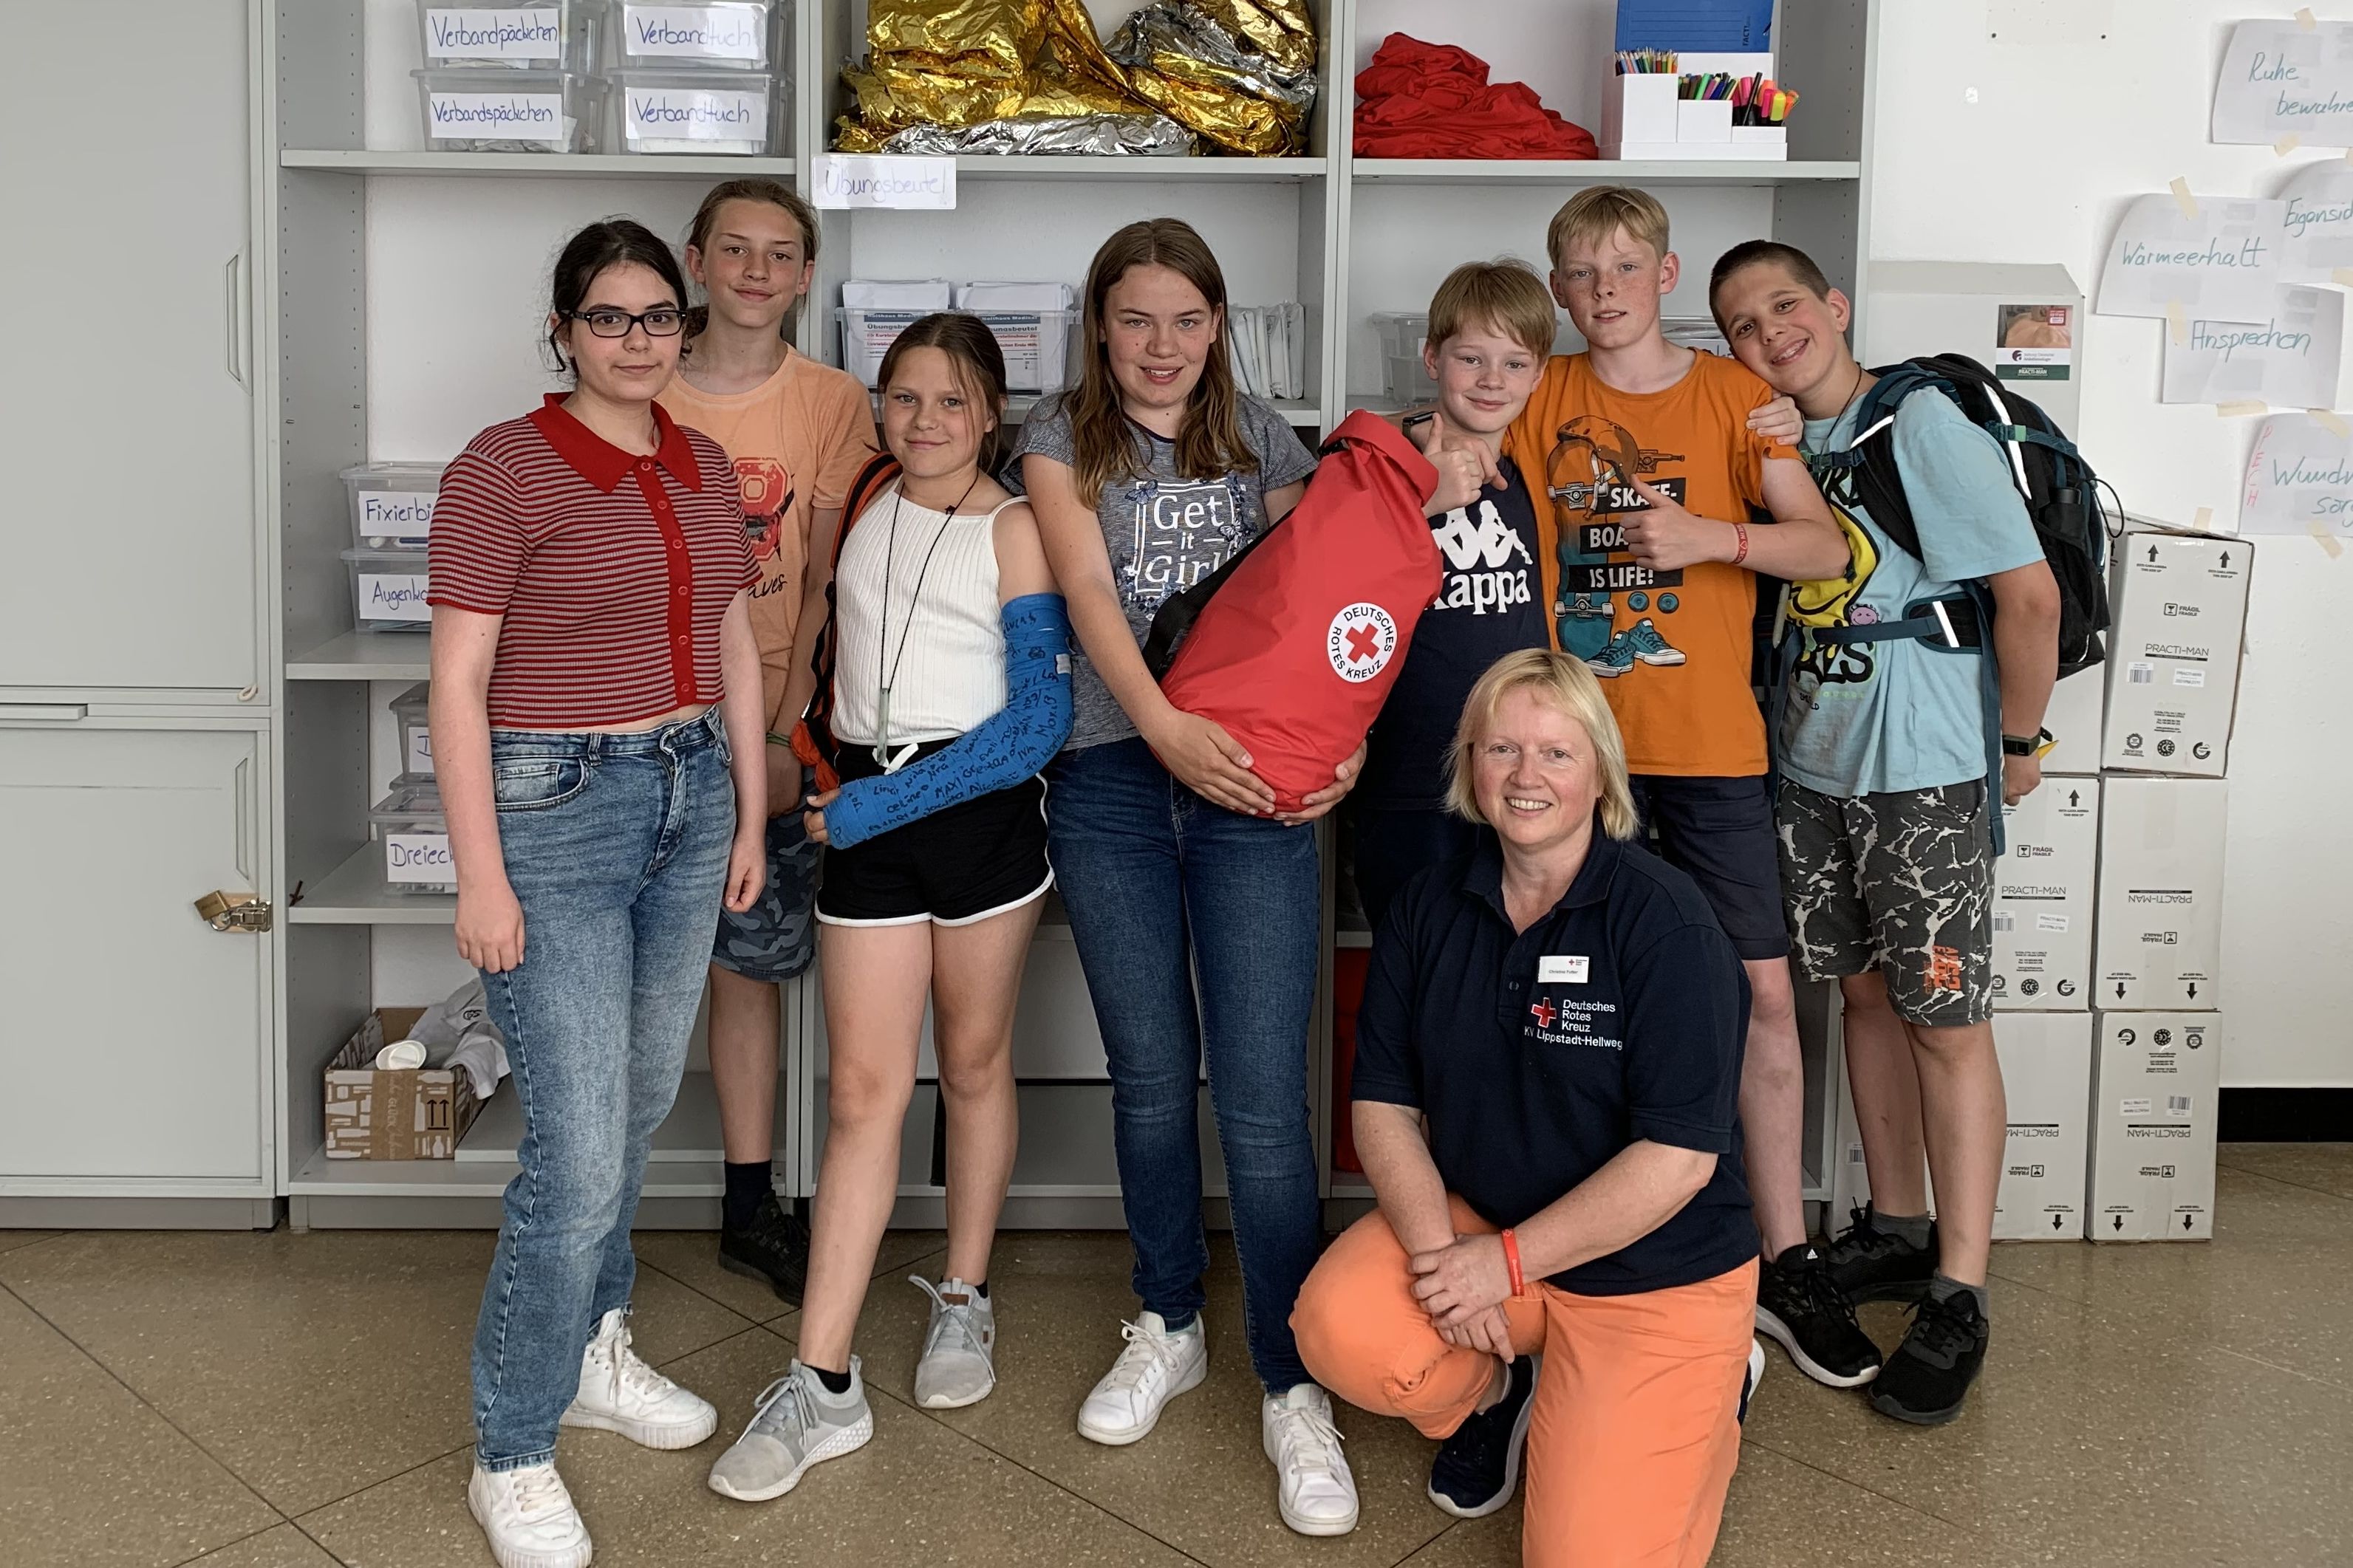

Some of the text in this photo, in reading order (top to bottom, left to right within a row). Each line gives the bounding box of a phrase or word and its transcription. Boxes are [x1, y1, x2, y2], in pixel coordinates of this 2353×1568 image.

[636, 16, 751, 47] Verbandtuch
[2249, 52, 2299, 82] Ruhe
[635, 96, 750, 124] Verbandtuch
[826, 162, 946, 203] Übungsbeutel
[2123, 237, 2267, 268] Wärmeerhalt
[2191, 318, 2312, 362] Ansprechen
[1610, 483, 1677, 508] SKAE-
[366, 497, 431, 521] Fixierbi
[1153, 495, 1225, 530] Get
[1181, 532, 1195, 550] it
[1145, 552, 1221, 586] Girl
[1590, 566, 1654, 588] IS LIFE!
[1343, 606, 1394, 652] DEUTSCHES
[1331, 626, 1345, 670] ROTES
[2145, 643, 2210, 656] PRACTI-MAN
[1345, 659, 1383, 679] KREUZ
[2002, 886, 2066, 894] PRACTI-MAN
[2128, 895, 2193, 904] PRACTI-MAN
[1562, 1010, 1591, 1021] Rotes
[1563, 999, 1616, 1013] Deutsches
[1524, 1026, 1623, 1051] KV Lippstadt-Hellweg
[1562, 1020, 1591, 1033] Kreuz
[2128, 1129, 2191, 1138] PRACTI-MAN
